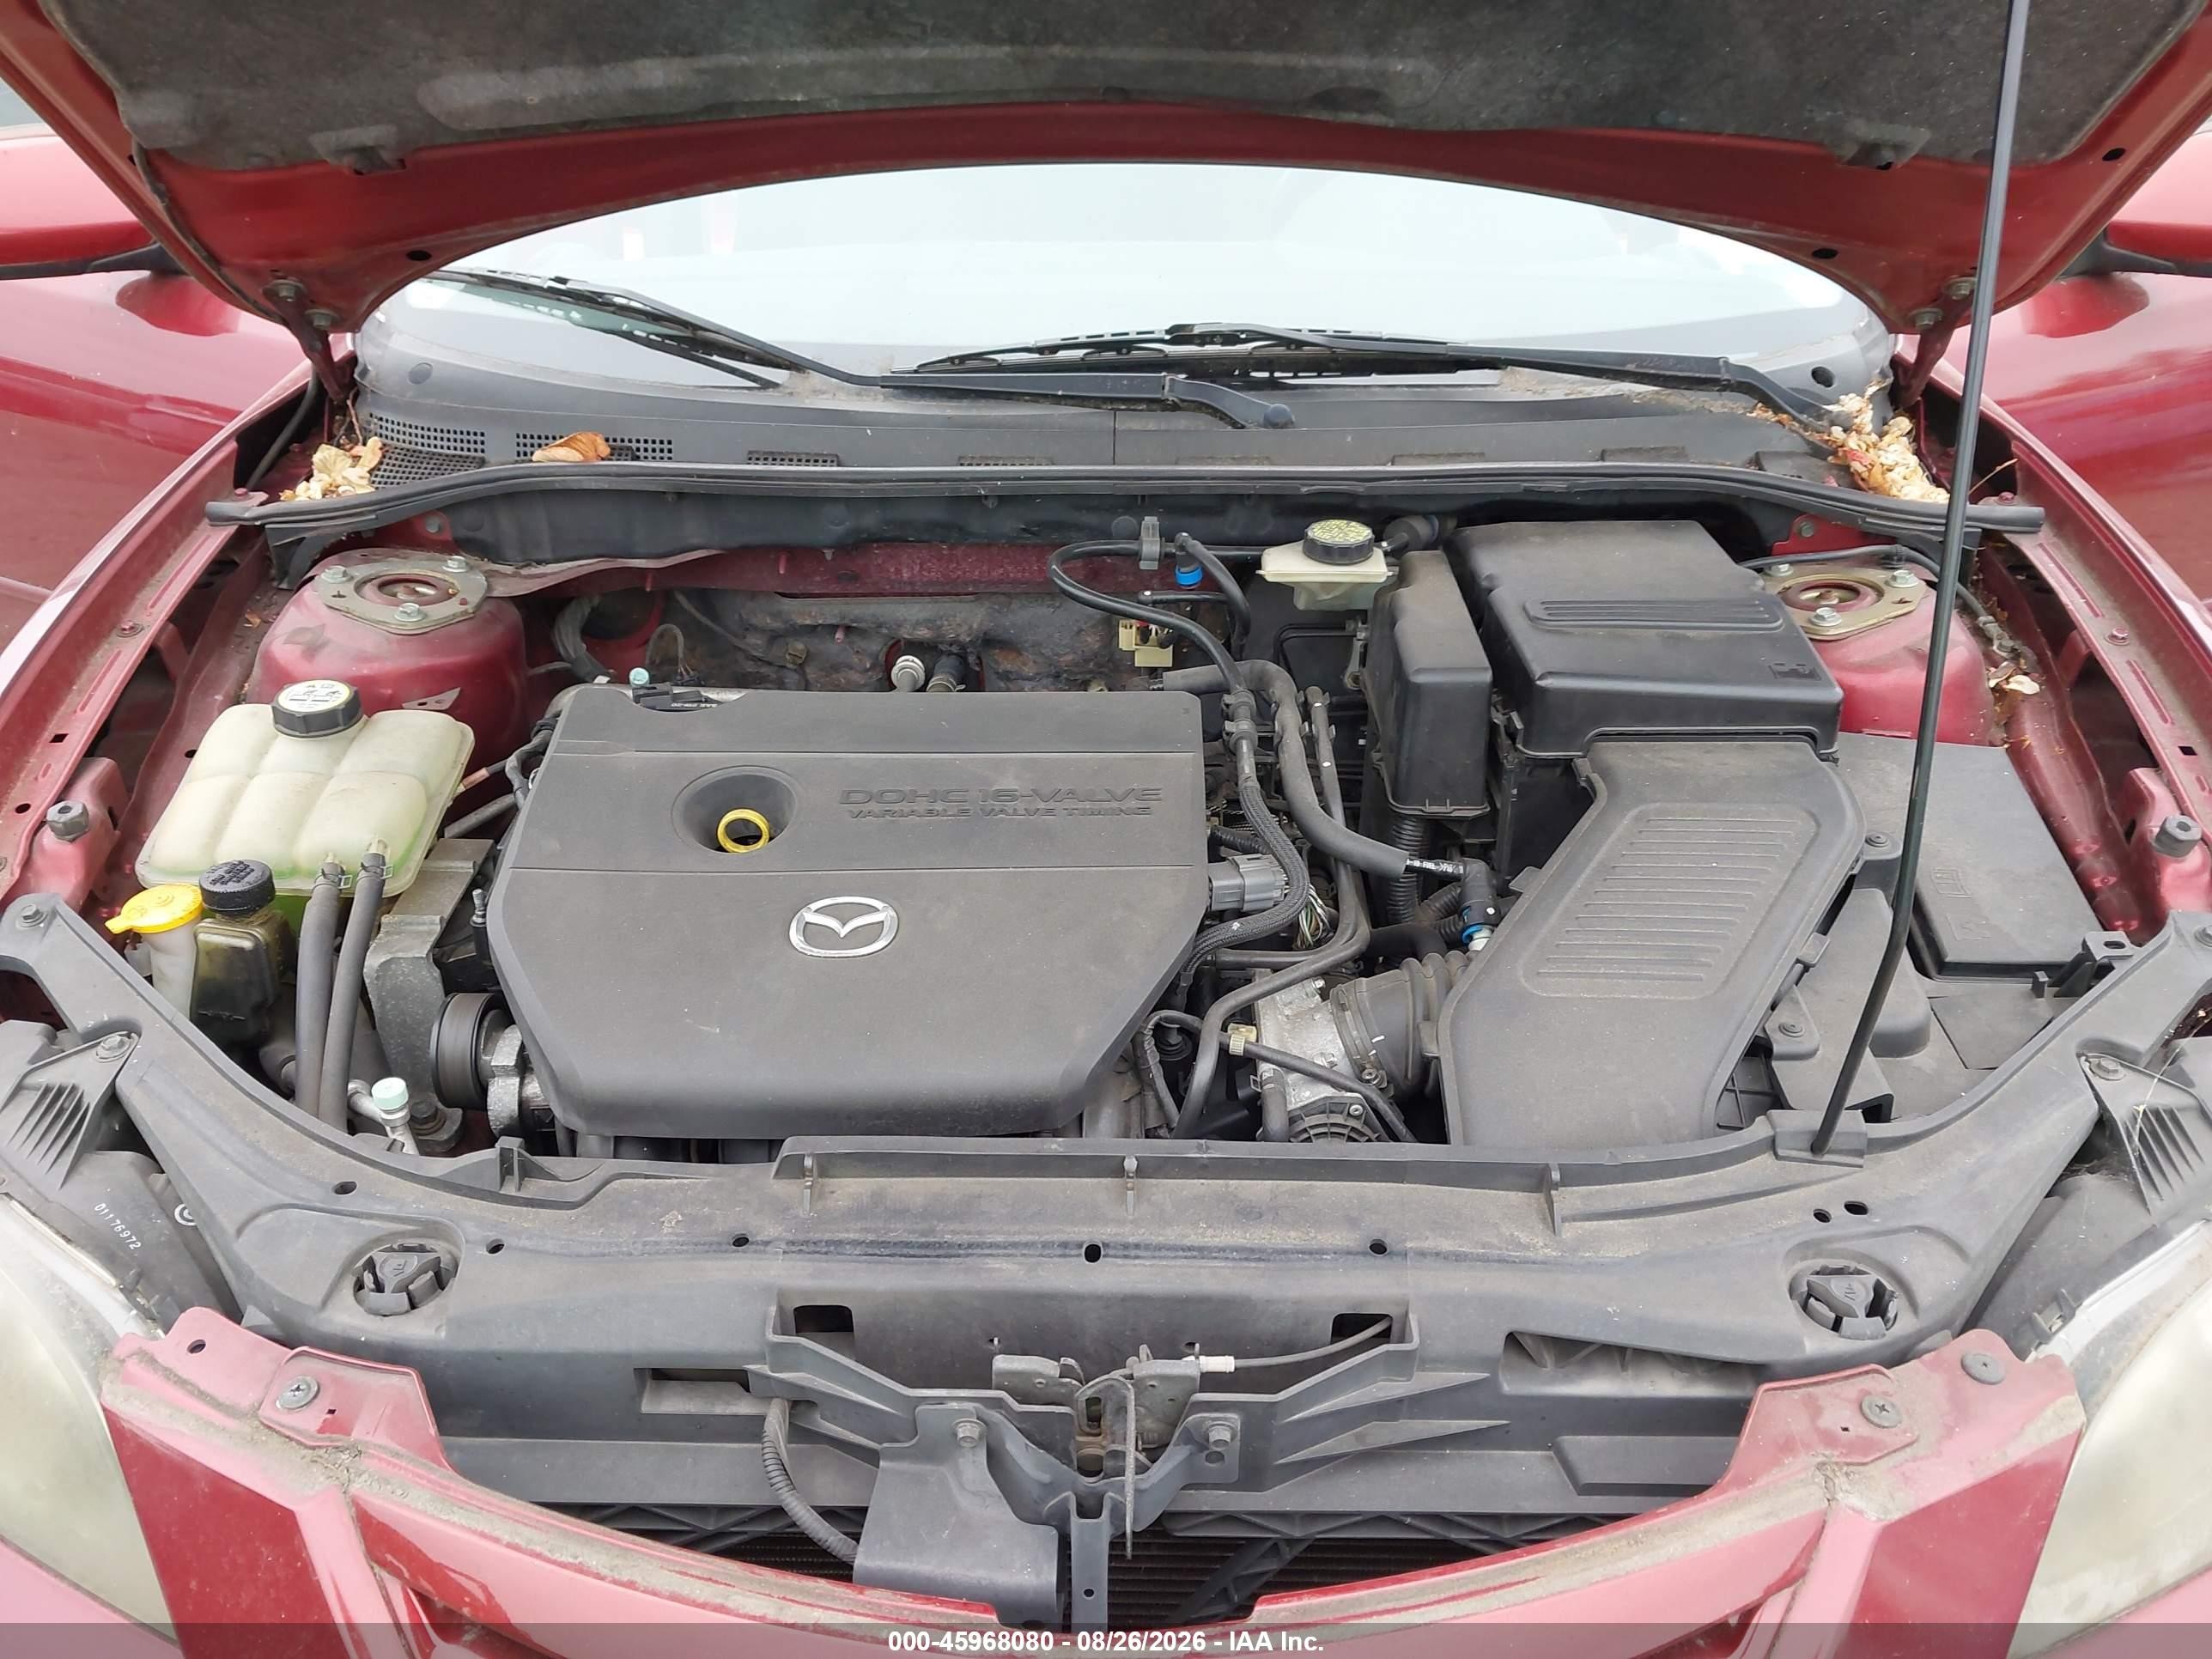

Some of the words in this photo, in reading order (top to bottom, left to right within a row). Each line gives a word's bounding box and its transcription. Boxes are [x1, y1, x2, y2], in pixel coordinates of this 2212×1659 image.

[839, 788, 969, 805] DOHC
[978, 787, 1163, 804] 16-VALVE
[847, 808, 971, 818] VARIABLE
[979, 807, 1057, 817] VALVE
[1062, 806, 1152, 817] TIMING
[94, 1202, 142, 1250] 01176972
